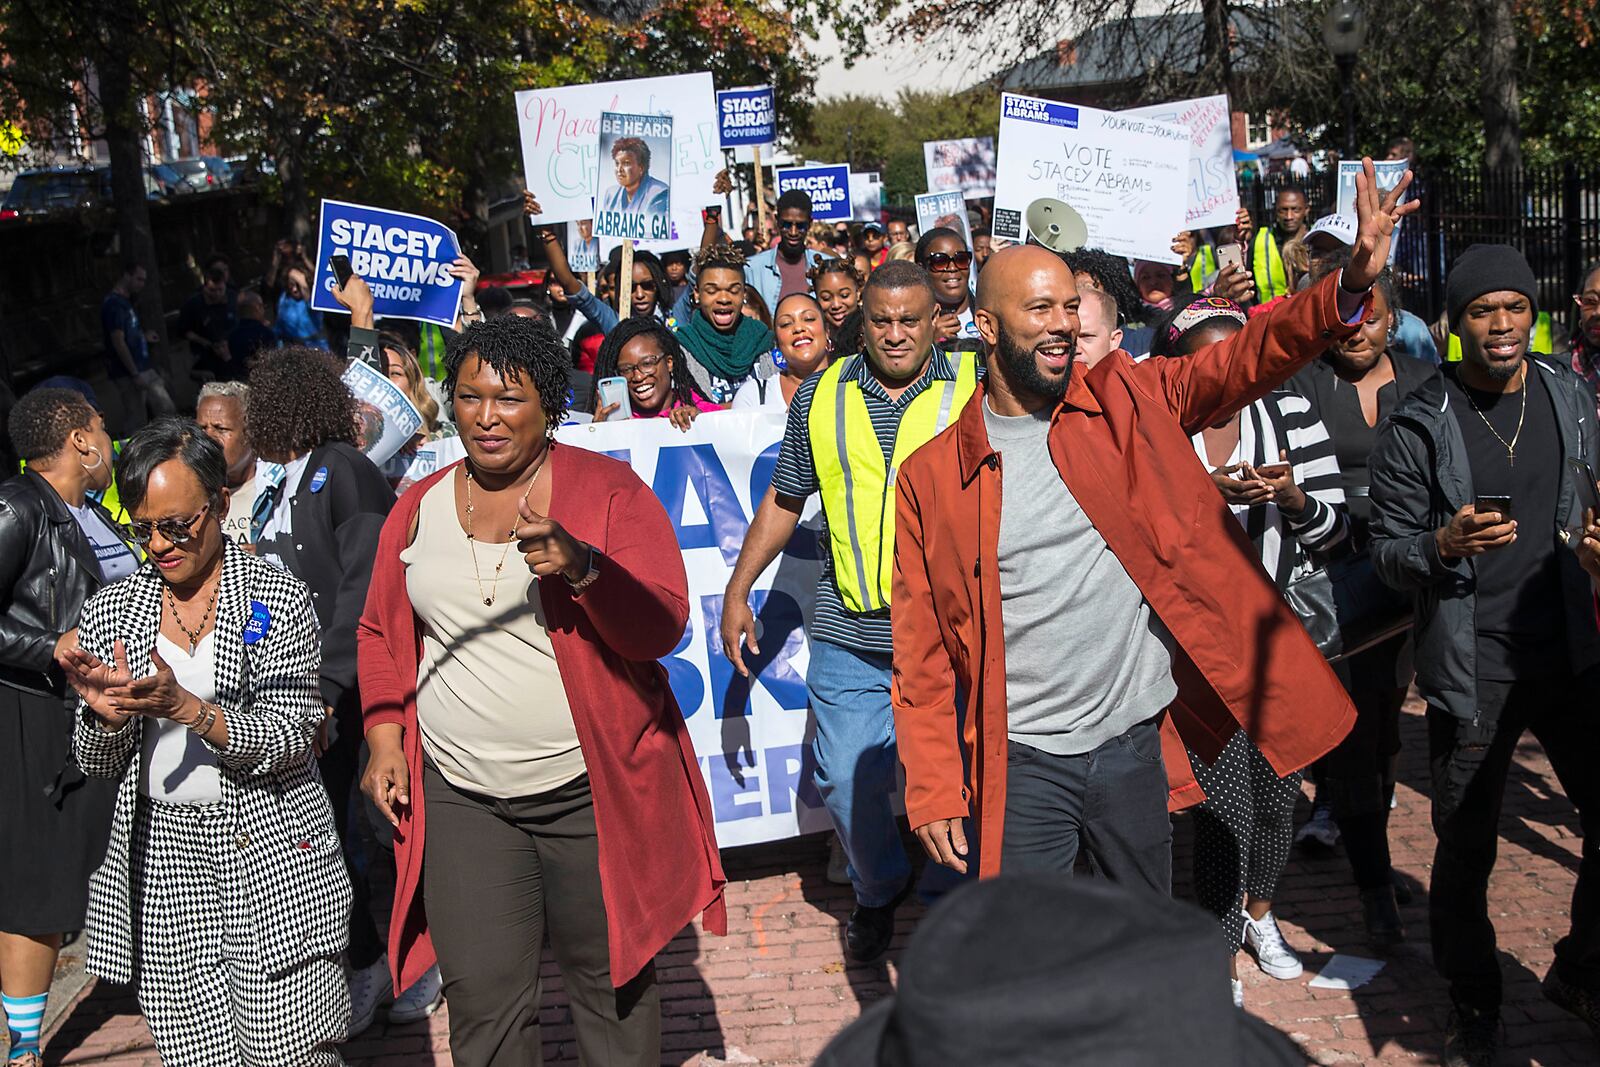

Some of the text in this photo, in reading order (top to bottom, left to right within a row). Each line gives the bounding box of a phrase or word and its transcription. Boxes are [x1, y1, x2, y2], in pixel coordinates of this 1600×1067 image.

[722, 96, 770, 113] STACEY
[1006, 97, 1047, 112] STACEY
[723, 109, 774, 128] ABRAMS
[1006, 107, 1050, 122] ABRAMS
[602, 120, 672, 138] BE HEARD
[1063, 142, 1112, 169] VOTE
[1027, 159, 1092, 183] STACEY
[781, 175, 835, 192] STACEY
[920, 202, 938, 217] BE
[596, 210, 645, 239] ABRAMS
[652, 214, 669, 239] GA
[330, 218, 442, 259] STACEY
[367, 385, 416, 437] HEARD
